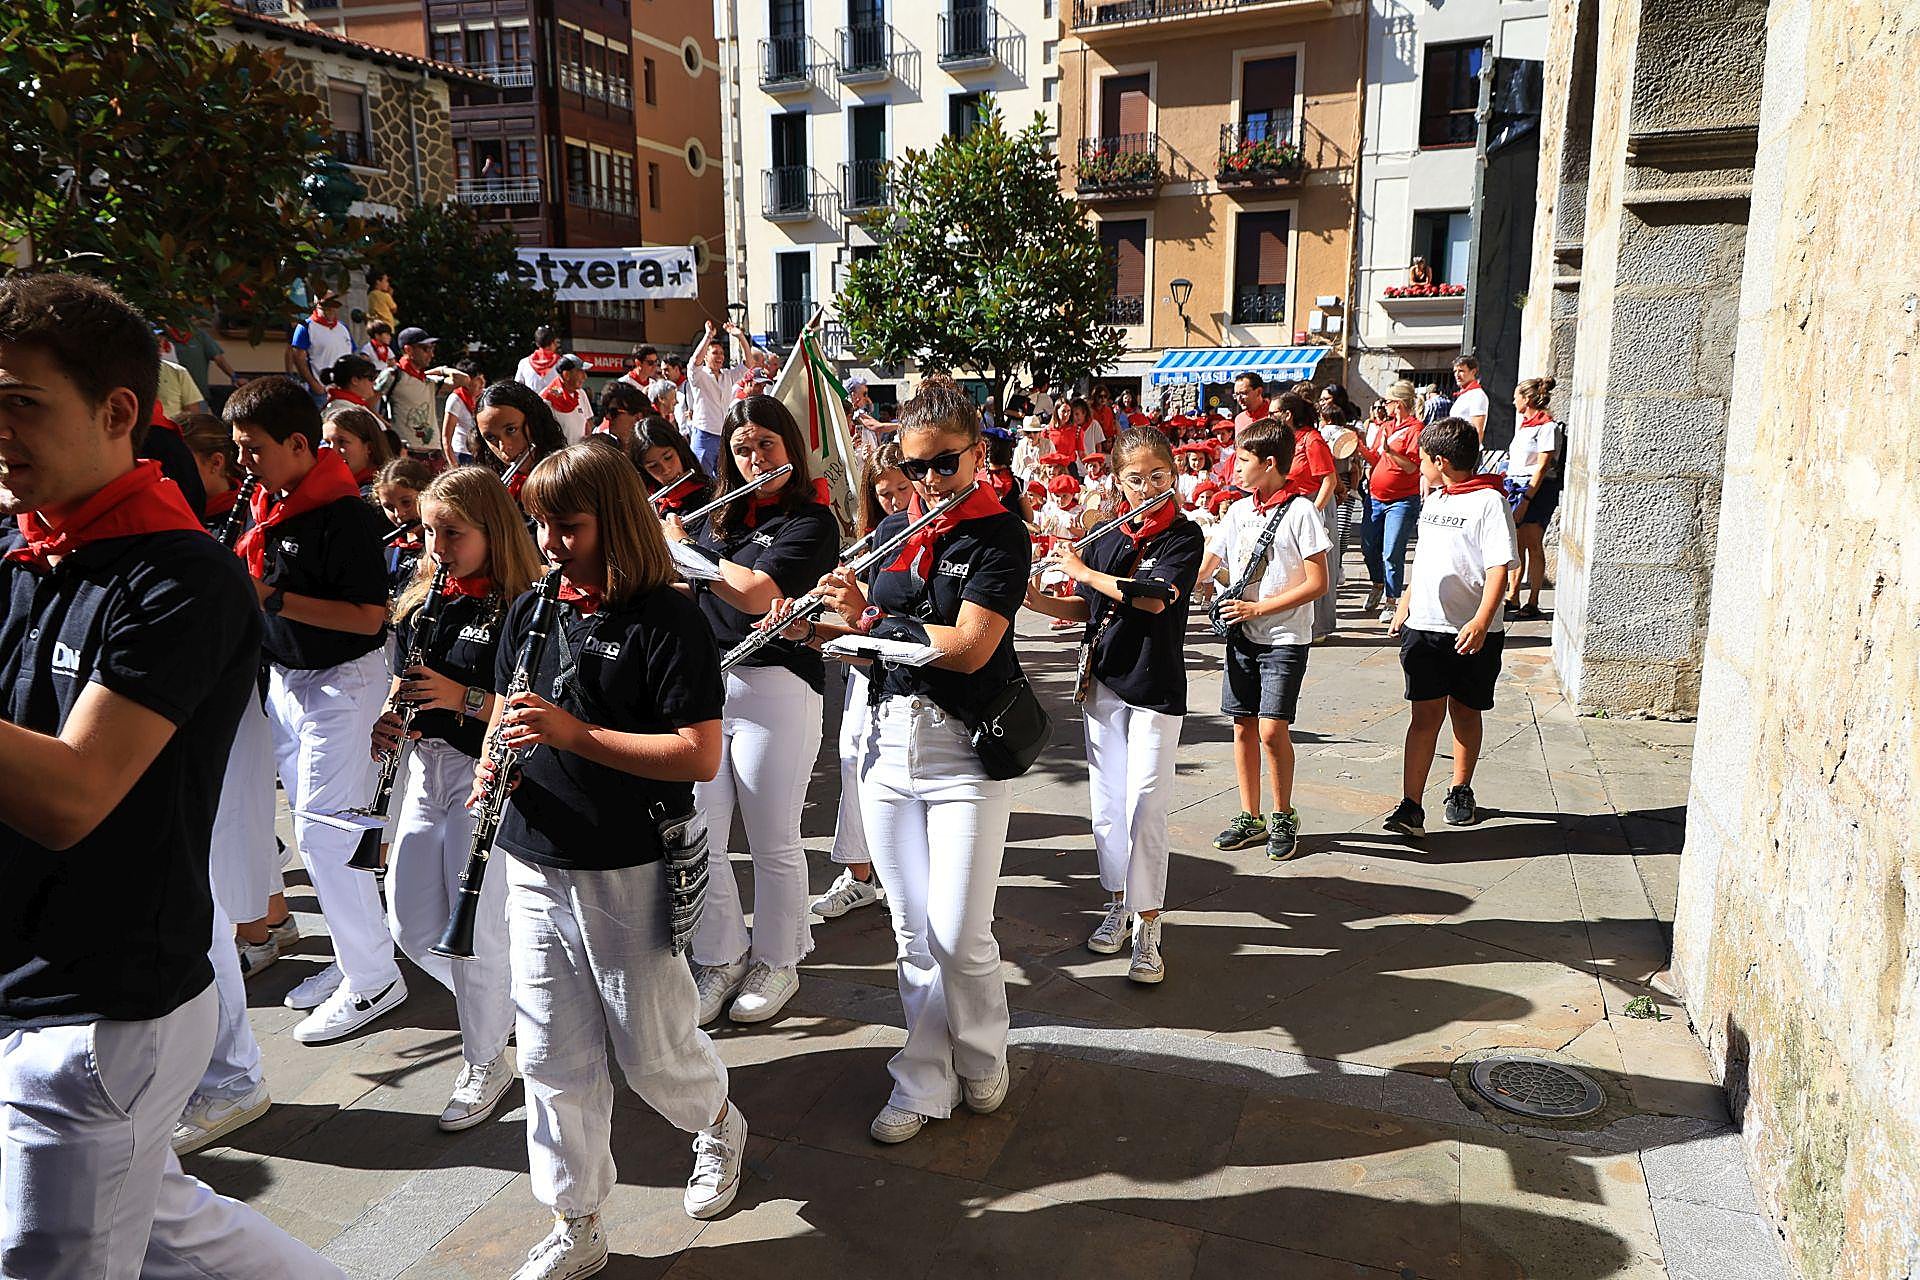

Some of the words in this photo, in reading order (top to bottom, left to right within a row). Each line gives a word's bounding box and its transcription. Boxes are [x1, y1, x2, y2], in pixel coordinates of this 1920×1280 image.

[509, 252, 664, 290] etxera
[593, 356, 624, 368] MAPF
[1441, 515, 1468, 527] SPOT
